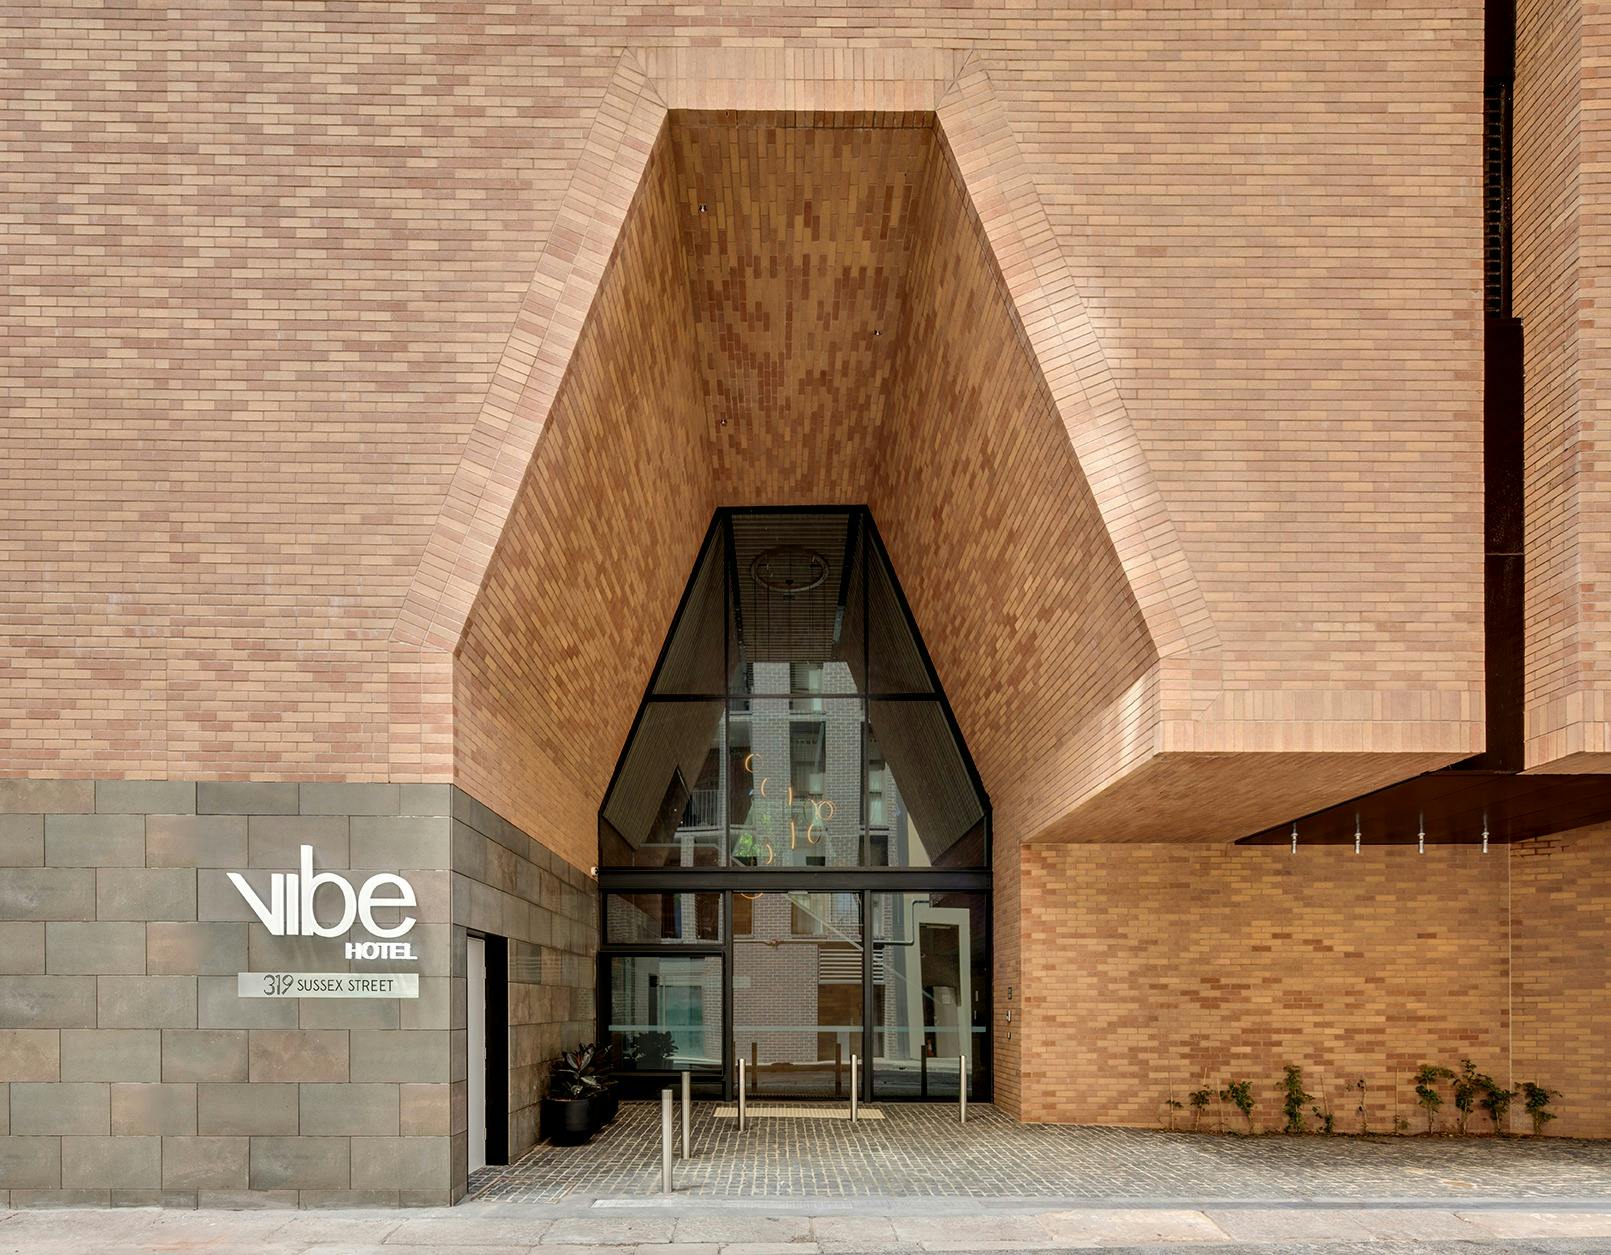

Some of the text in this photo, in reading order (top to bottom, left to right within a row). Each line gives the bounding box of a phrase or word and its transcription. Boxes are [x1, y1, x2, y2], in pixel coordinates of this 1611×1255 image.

[226, 844, 417, 938] vibe
[345, 942, 418, 960] HOTEL
[263, 974, 394, 996] 319 SUSSEX STREET
